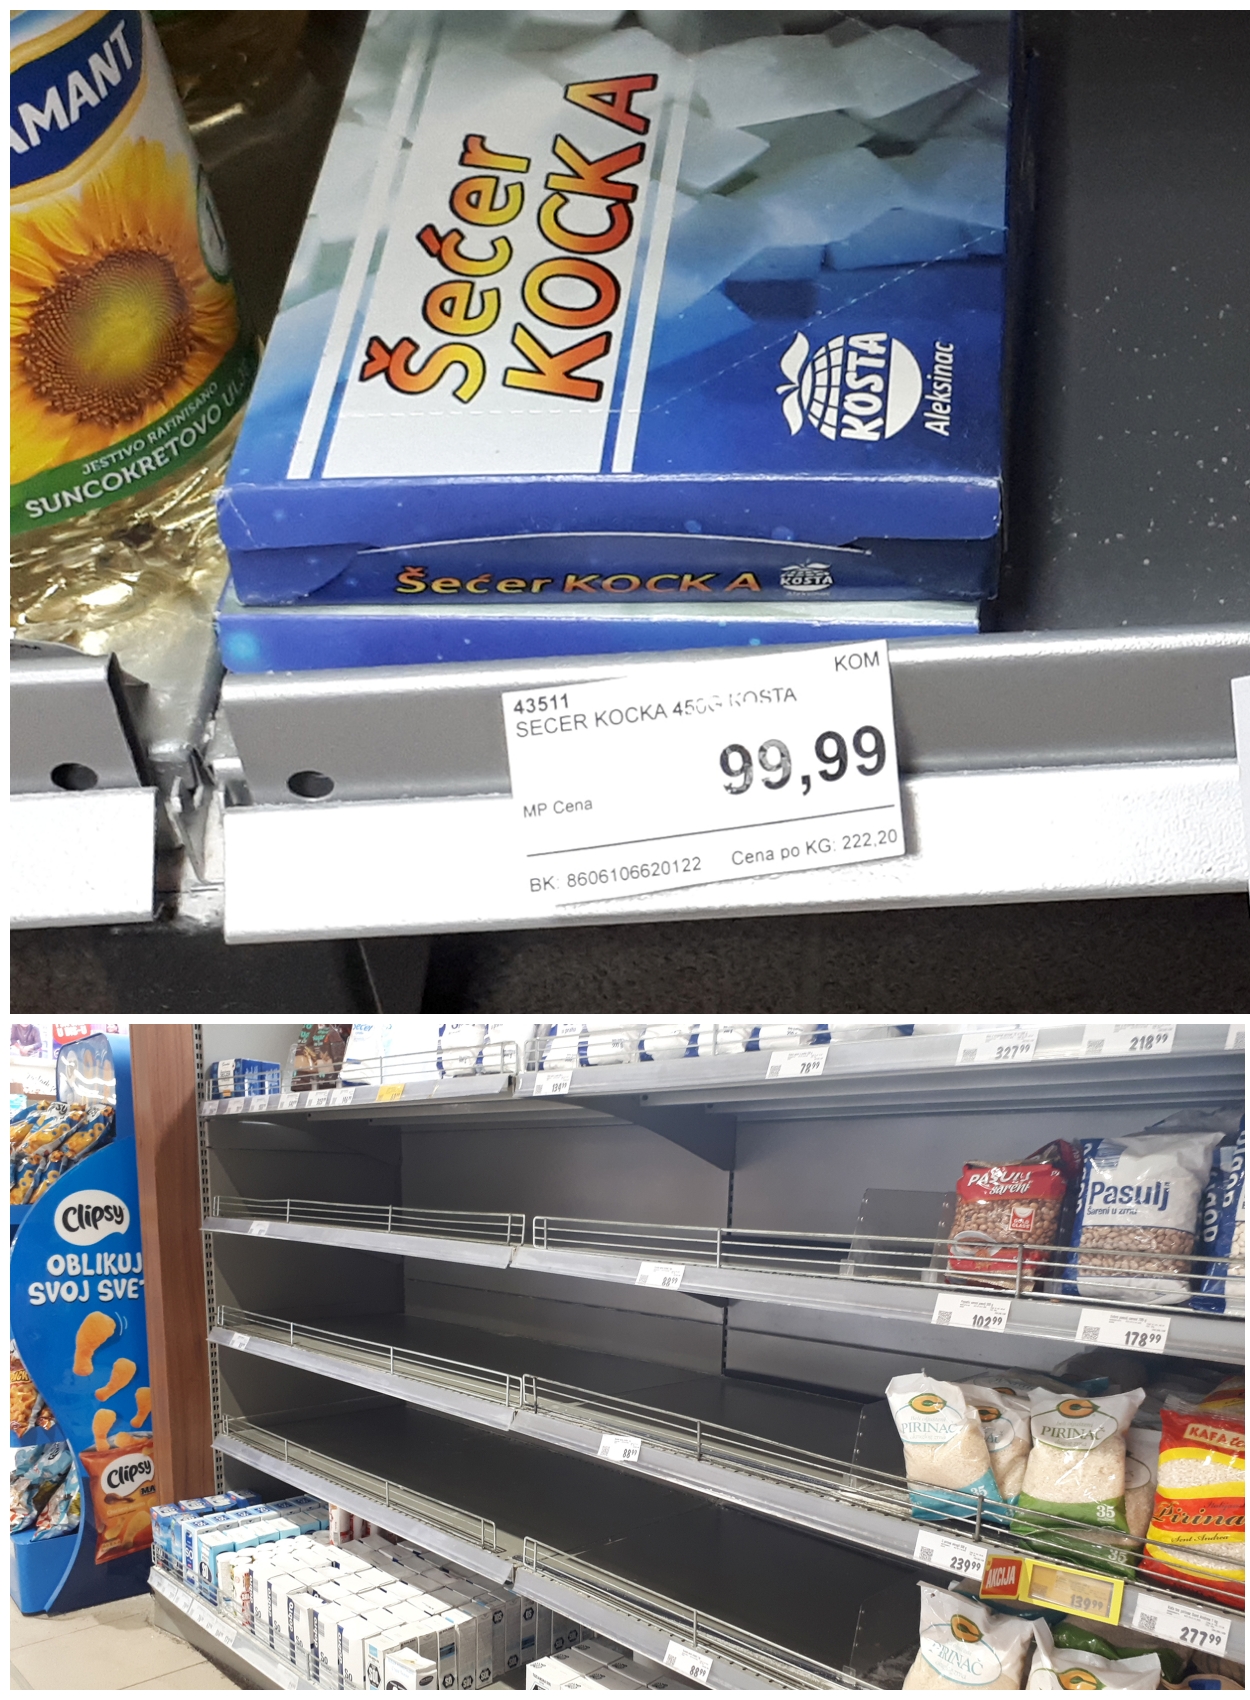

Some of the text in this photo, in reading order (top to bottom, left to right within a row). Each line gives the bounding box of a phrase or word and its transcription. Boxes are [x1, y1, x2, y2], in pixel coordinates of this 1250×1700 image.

[359, 134, 530, 404] Šećer
[840, 332, 889, 441] KOSTA
[924, 341, 955, 437] Aleksinac
[82, 438, 146, 475] JESTIVO
[147, 381, 218, 443] RAFINISANO
[25, 403, 222, 519] SUNCOKRETOVO
[395, 566, 553, 594] Šećer
[780, 575, 834, 587] KOSTA
[834, 651, 880, 672] KOM
[513, 693, 569, 715] 43511
[516, 714, 588, 738] SECER
[595, 706, 667, 728] KOCKA
[719, 725, 887, 795] 99,99
[523, 799, 594, 819] MP Cena
[731, 828, 898, 866] Cena po KG: 222,20
[529, 856, 702, 893] BK: 8606106620122
[1088, 1181, 1171, 1211] Pasulj
[62, 1203, 125, 1233] Clipsy
[1087, 1207, 1110, 1216] Šareni
[47, 1252, 143, 1277] OBLIKUJ
[28, 1281, 90, 1306] SVOJ
[1189, 1426, 1228, 1444] KAFA
[107, 1459, 151, 1489] Clipsy
[1096, 1504, 1116, 1518] 35
[985, 1565, 1016, 1589] AKCIJA
